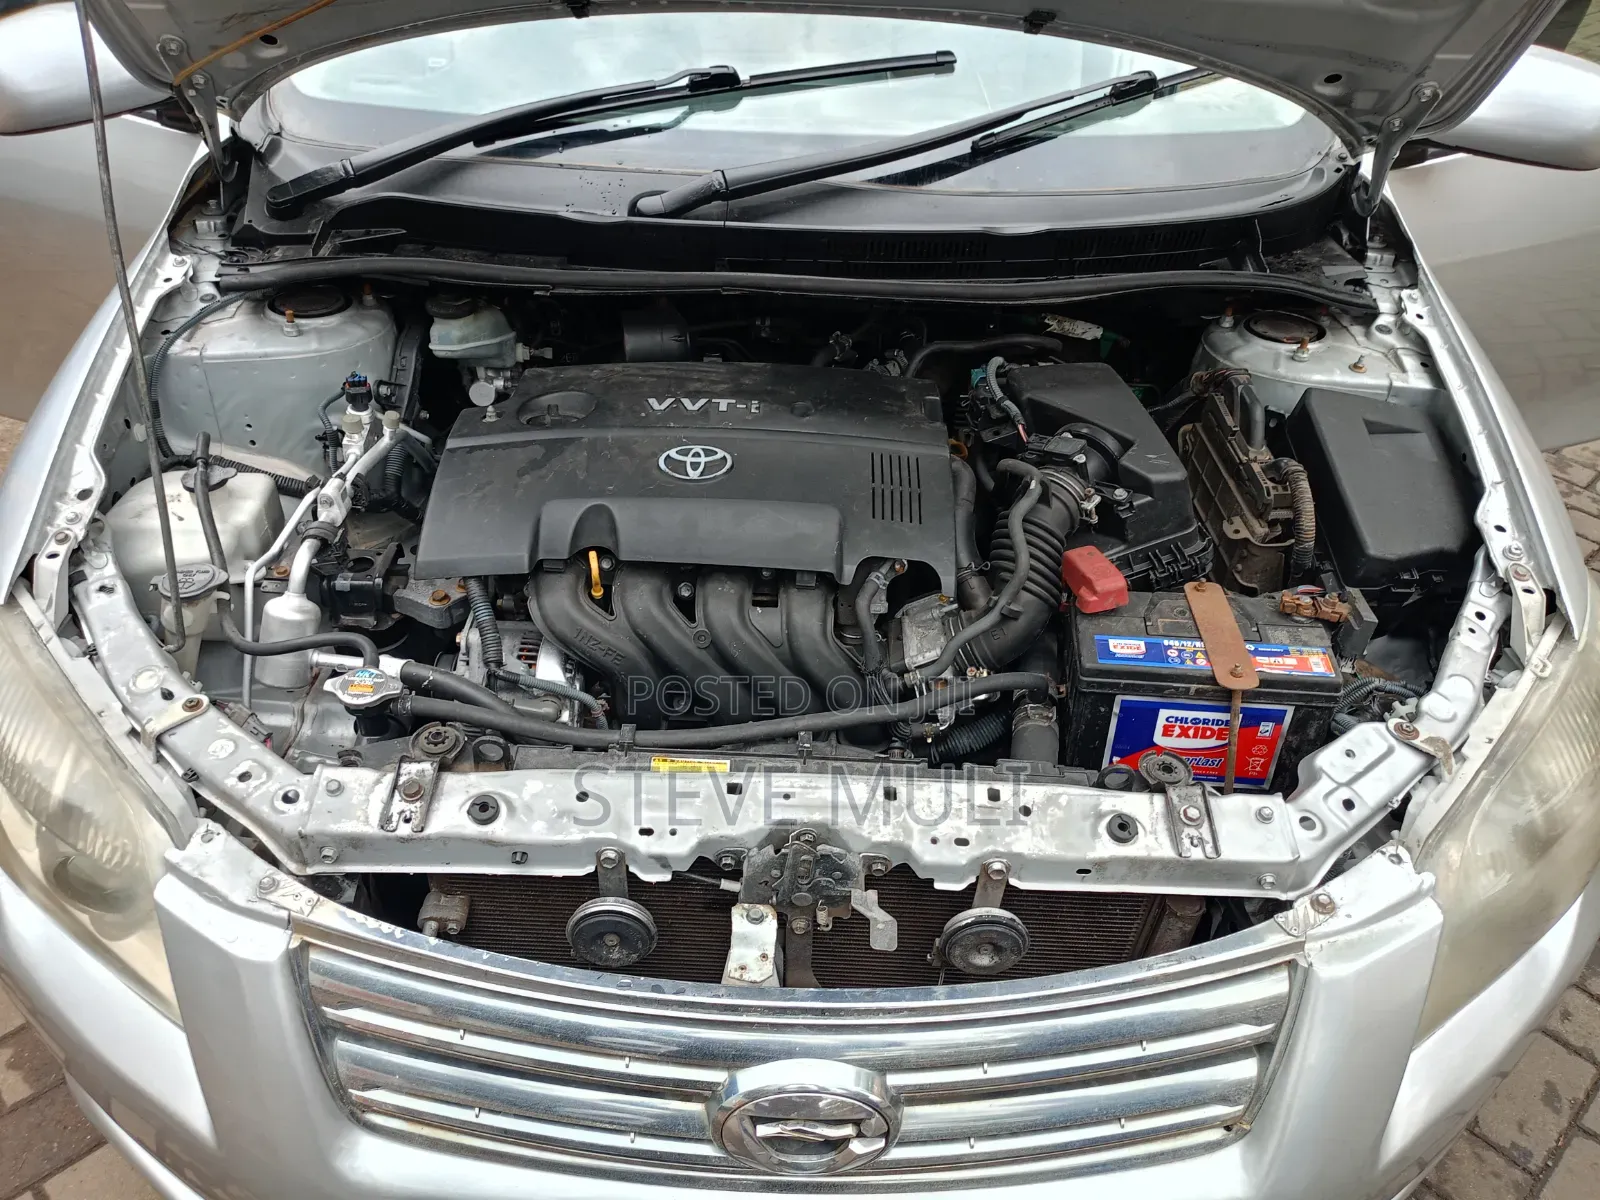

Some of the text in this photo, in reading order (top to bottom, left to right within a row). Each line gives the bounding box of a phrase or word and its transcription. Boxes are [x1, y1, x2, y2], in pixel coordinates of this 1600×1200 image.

[647, 397, 760, 413] VVT-i
[573, 626, 628, 666] 1NZ-FE
[1165, 715, 1231, 727] CHLORIDE
[1161, 723, 1230, 741] EXIDE
